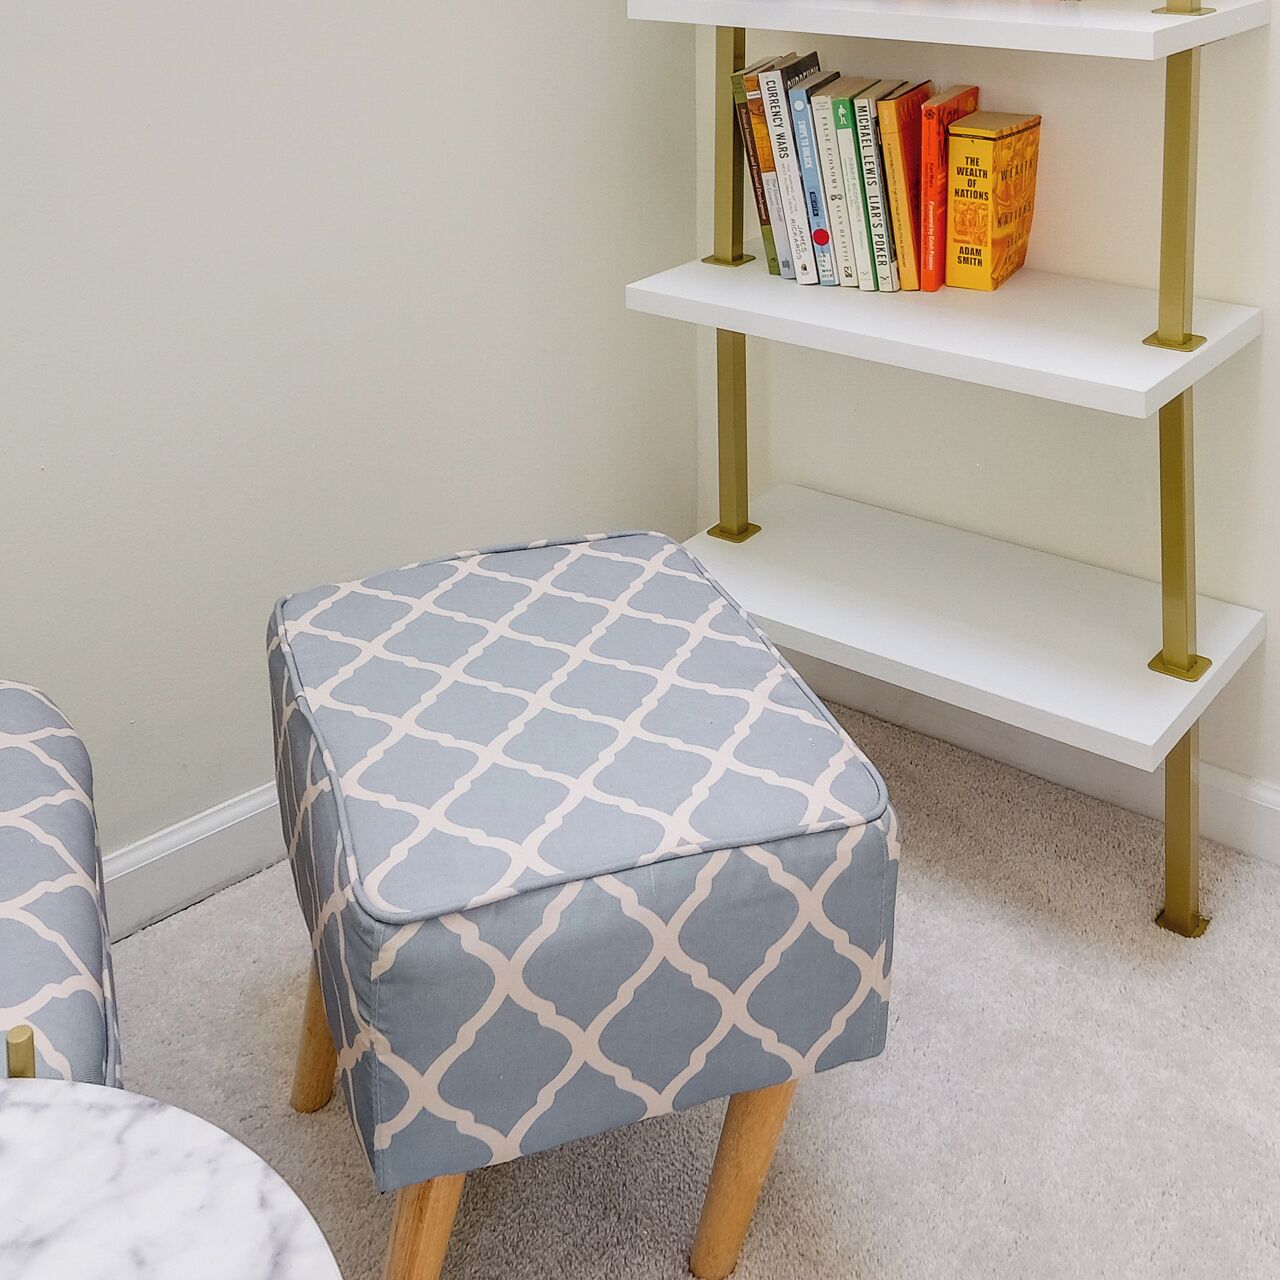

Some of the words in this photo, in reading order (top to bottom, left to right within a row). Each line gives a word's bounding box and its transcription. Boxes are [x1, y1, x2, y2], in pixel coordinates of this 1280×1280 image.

[766, 80, 784, 134] CURRENCY
[775, 133, 789, 159] WARS
[857, 105, 871, 151] MICHAEL
[965, 156, 980, 166] THE
[863, 155, 877, 187] LEWIS
[956, 166, 988, 178] WEALTH
[967, 178, 977, 187] OF
[954, 188, 989, 201] NATIONS
[869, 195, 882, 229] LIAR'S
[874, 234, 888, 266] POKER
[959, 246, 981, 257] ADAM
[958, 256, 983, 266] SMITH
